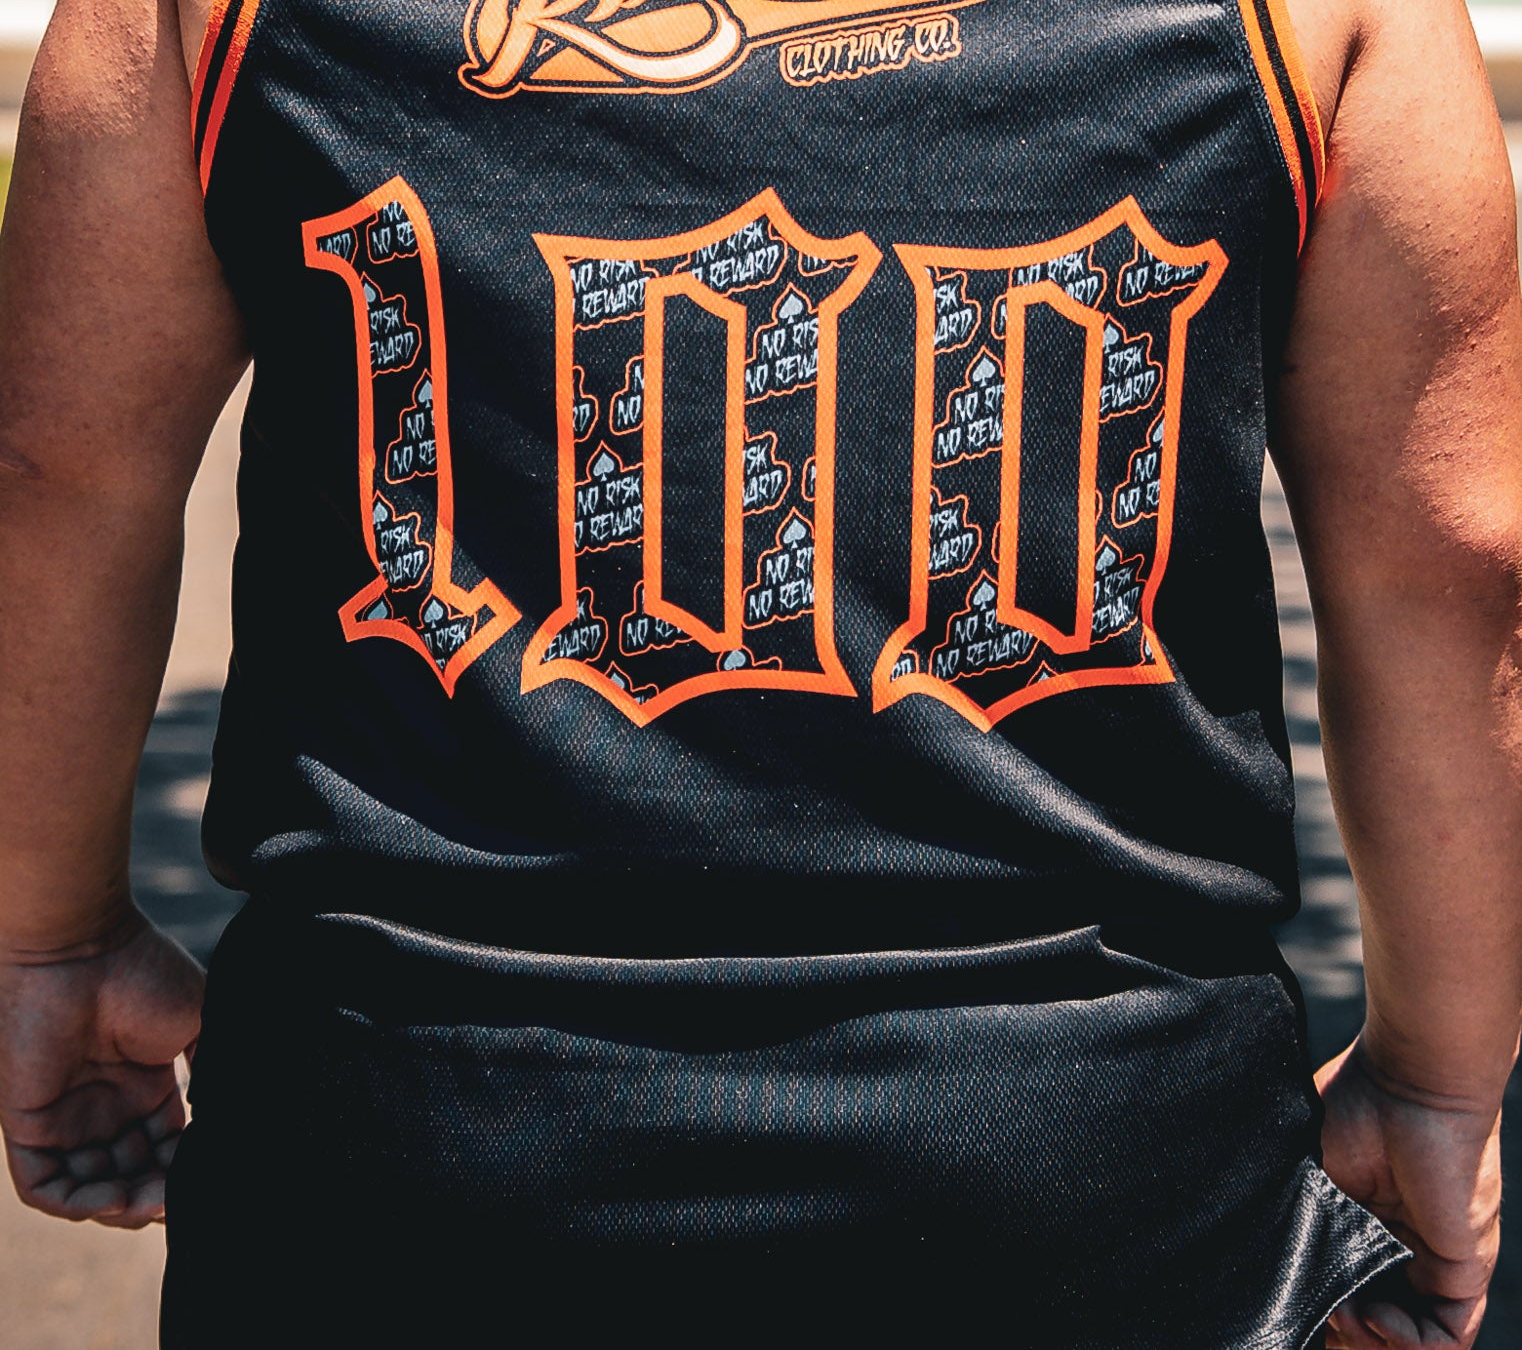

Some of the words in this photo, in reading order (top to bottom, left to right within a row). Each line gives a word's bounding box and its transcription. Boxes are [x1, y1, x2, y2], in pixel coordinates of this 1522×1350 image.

[786, 25, 906, 78] CLOTHING
[914, 18, 952, 52] CO.
[371, 227, 391, 255] NO
[709, 244, 779, 288] REWARD
[1125, 266, 1149, 298] NO
[369, 331, 415, 365] EWARD
[762, 328, 786, 360] NO
[793, 317, 819, 348] RIS
[775, 349, 818, 387] REWA
[1108, 346, 1142, 377] RISK
[1099, 369, 1155, 412] EWARD
[617, 395, 641, 427] NO
[954, 392, 978, 424] NO
[406, 413, 424, 439] NO
[937, 426, 961, 459] NO
[302, 175, 1229, 733] 100
[392, 447, 413, 475] NO
[1135, 452, 1157, 482] NO
[577, 485, 599, 516] NO
[606, 471, 642, 506] RISK
[1119, 486, 1141, 520] NO
[380, 524, 412, 553] RISK
[590, 503, 643, 542] REWAR
[765, 554, 789, 586] NO
[1104, 566, 1134, 600] RISK
[749, 589, 772, 622] NO
[542, 624, 601, 662] EWARD
[627, 617, 649, 648] NO
[954, 614, 978, 645] NO
[936, 649, 960, 679] NO
